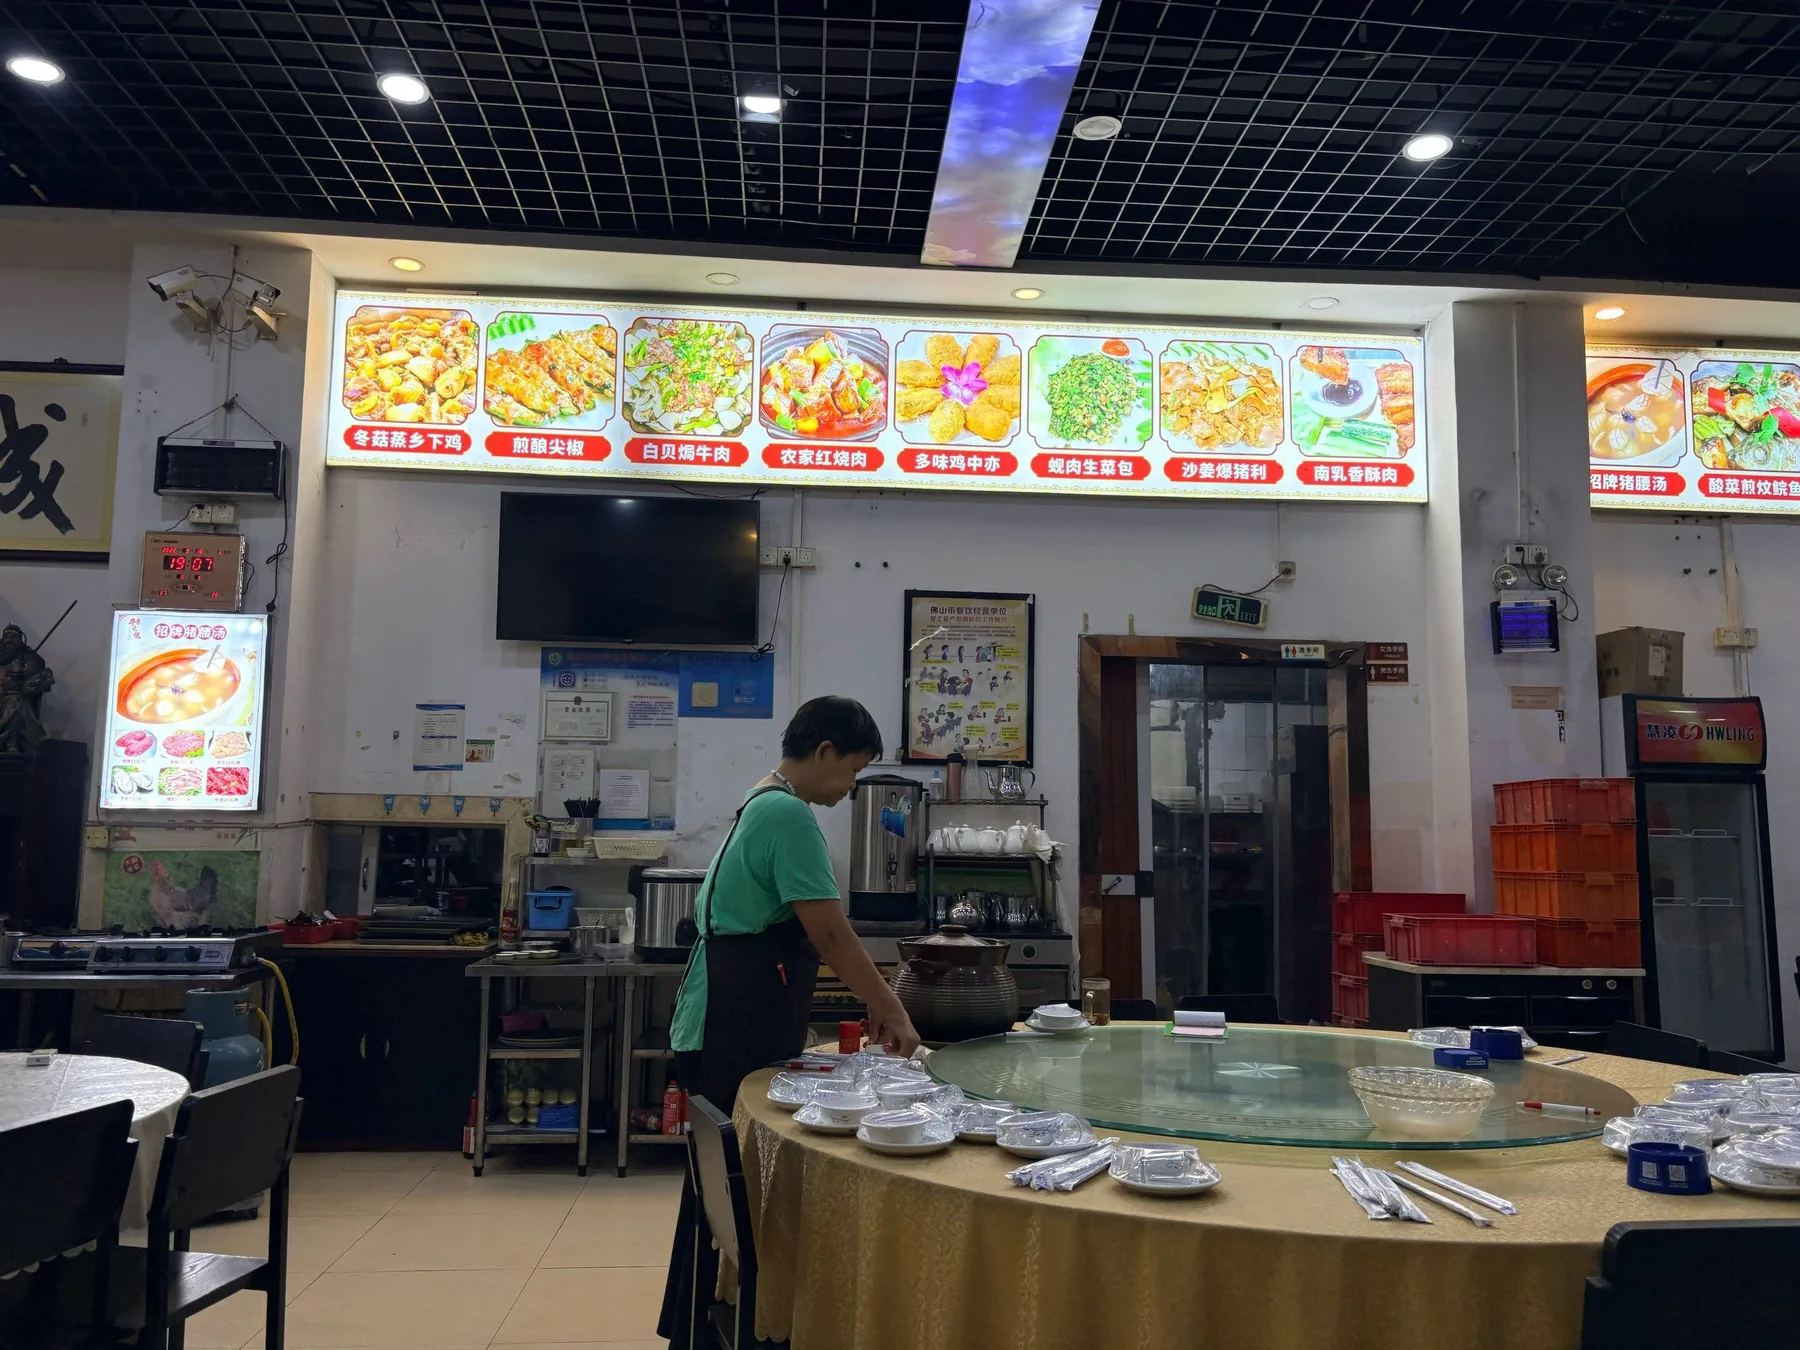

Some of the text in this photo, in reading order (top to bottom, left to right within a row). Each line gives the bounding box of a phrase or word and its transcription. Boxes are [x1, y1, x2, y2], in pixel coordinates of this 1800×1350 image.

[353, 429, 463, 451] 冬菇蒸乡下鸡
[512, 436, 585, 457] 煎酿尖椒
[643, 442, 730, 462] 白贝焗牛肉
[780, 448, 867, 468] 农家红烧肉
[914, 453, 1001, 472] 多味鸡中亦
[1047, 457, 1134, 477] 蚬肉生菜包
[1181, 461, 1267, 481] 沙姜爆猪利
[1313, 465, 1398, 483] 南乳香酥肉
[1590, 473, 1667, 492] 招牌猪腰汤
[930, 606, 1007, 615] 佛山市餐饮经营单位
[1198, 604, 1217, 616] 安全出口
[1240, 611, 1258, 623] EXIT
[156, 624, 226, 640] 招牌猪腰汤
[1298, 646, 1319, 654] 洗手间
[1646, 724, 1677, 739] 慧凌
[1706, 726, 1755, 741] HWLING
